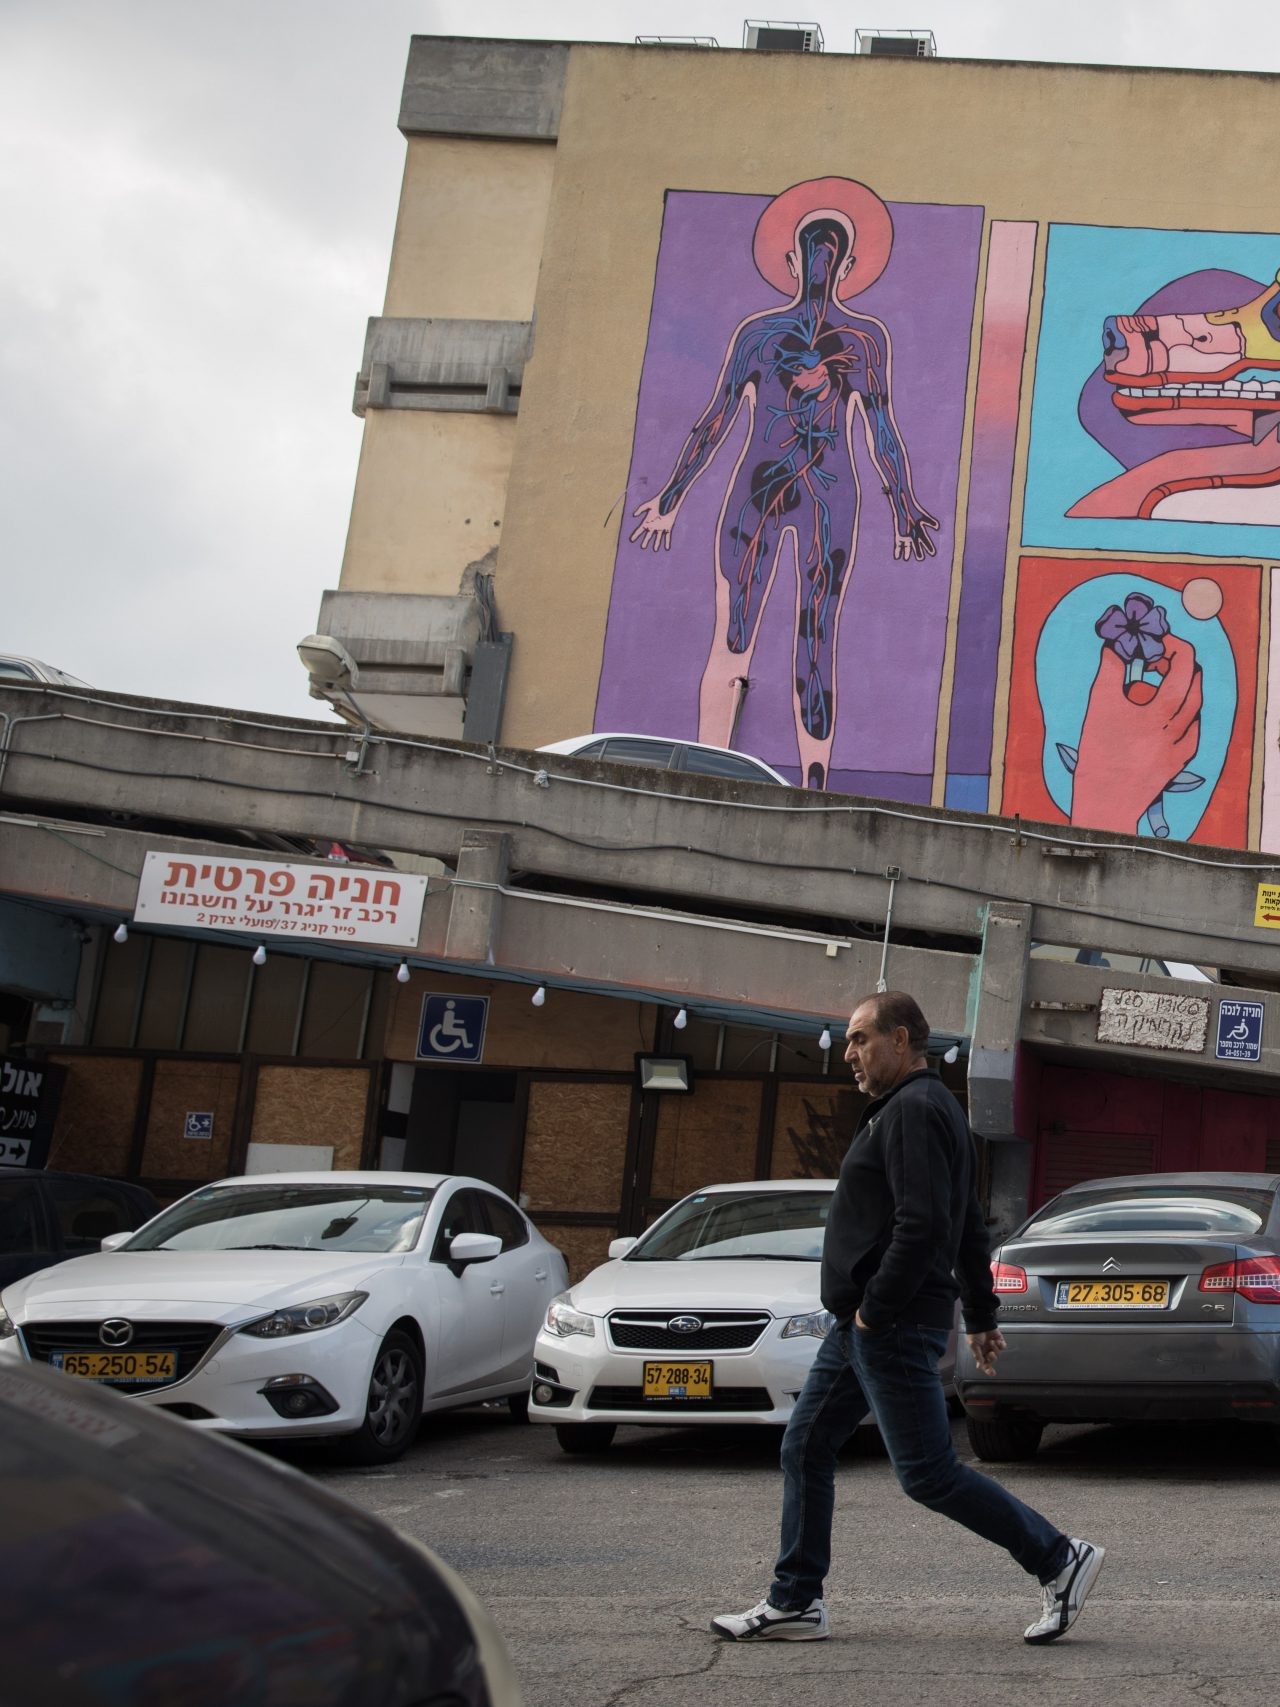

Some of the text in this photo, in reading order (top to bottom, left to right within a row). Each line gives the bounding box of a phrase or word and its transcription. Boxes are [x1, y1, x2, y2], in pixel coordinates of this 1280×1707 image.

[163, 861, 402, 906] חניה פרטית
[160, 890, 397, 925] רכב זר יגרר על חשבונו
[196, 912, 205, 923] 2
[208, 914, 236, 925] צדק
[301, 923, 329, 935] קניג
[332, 925, 357, 936] פייר
[1221, 1003, 1261, 1018] חניה לנכה
[0, 1062, 43, 1097] אול
[1201, 1303, 1226, 1312] C5
